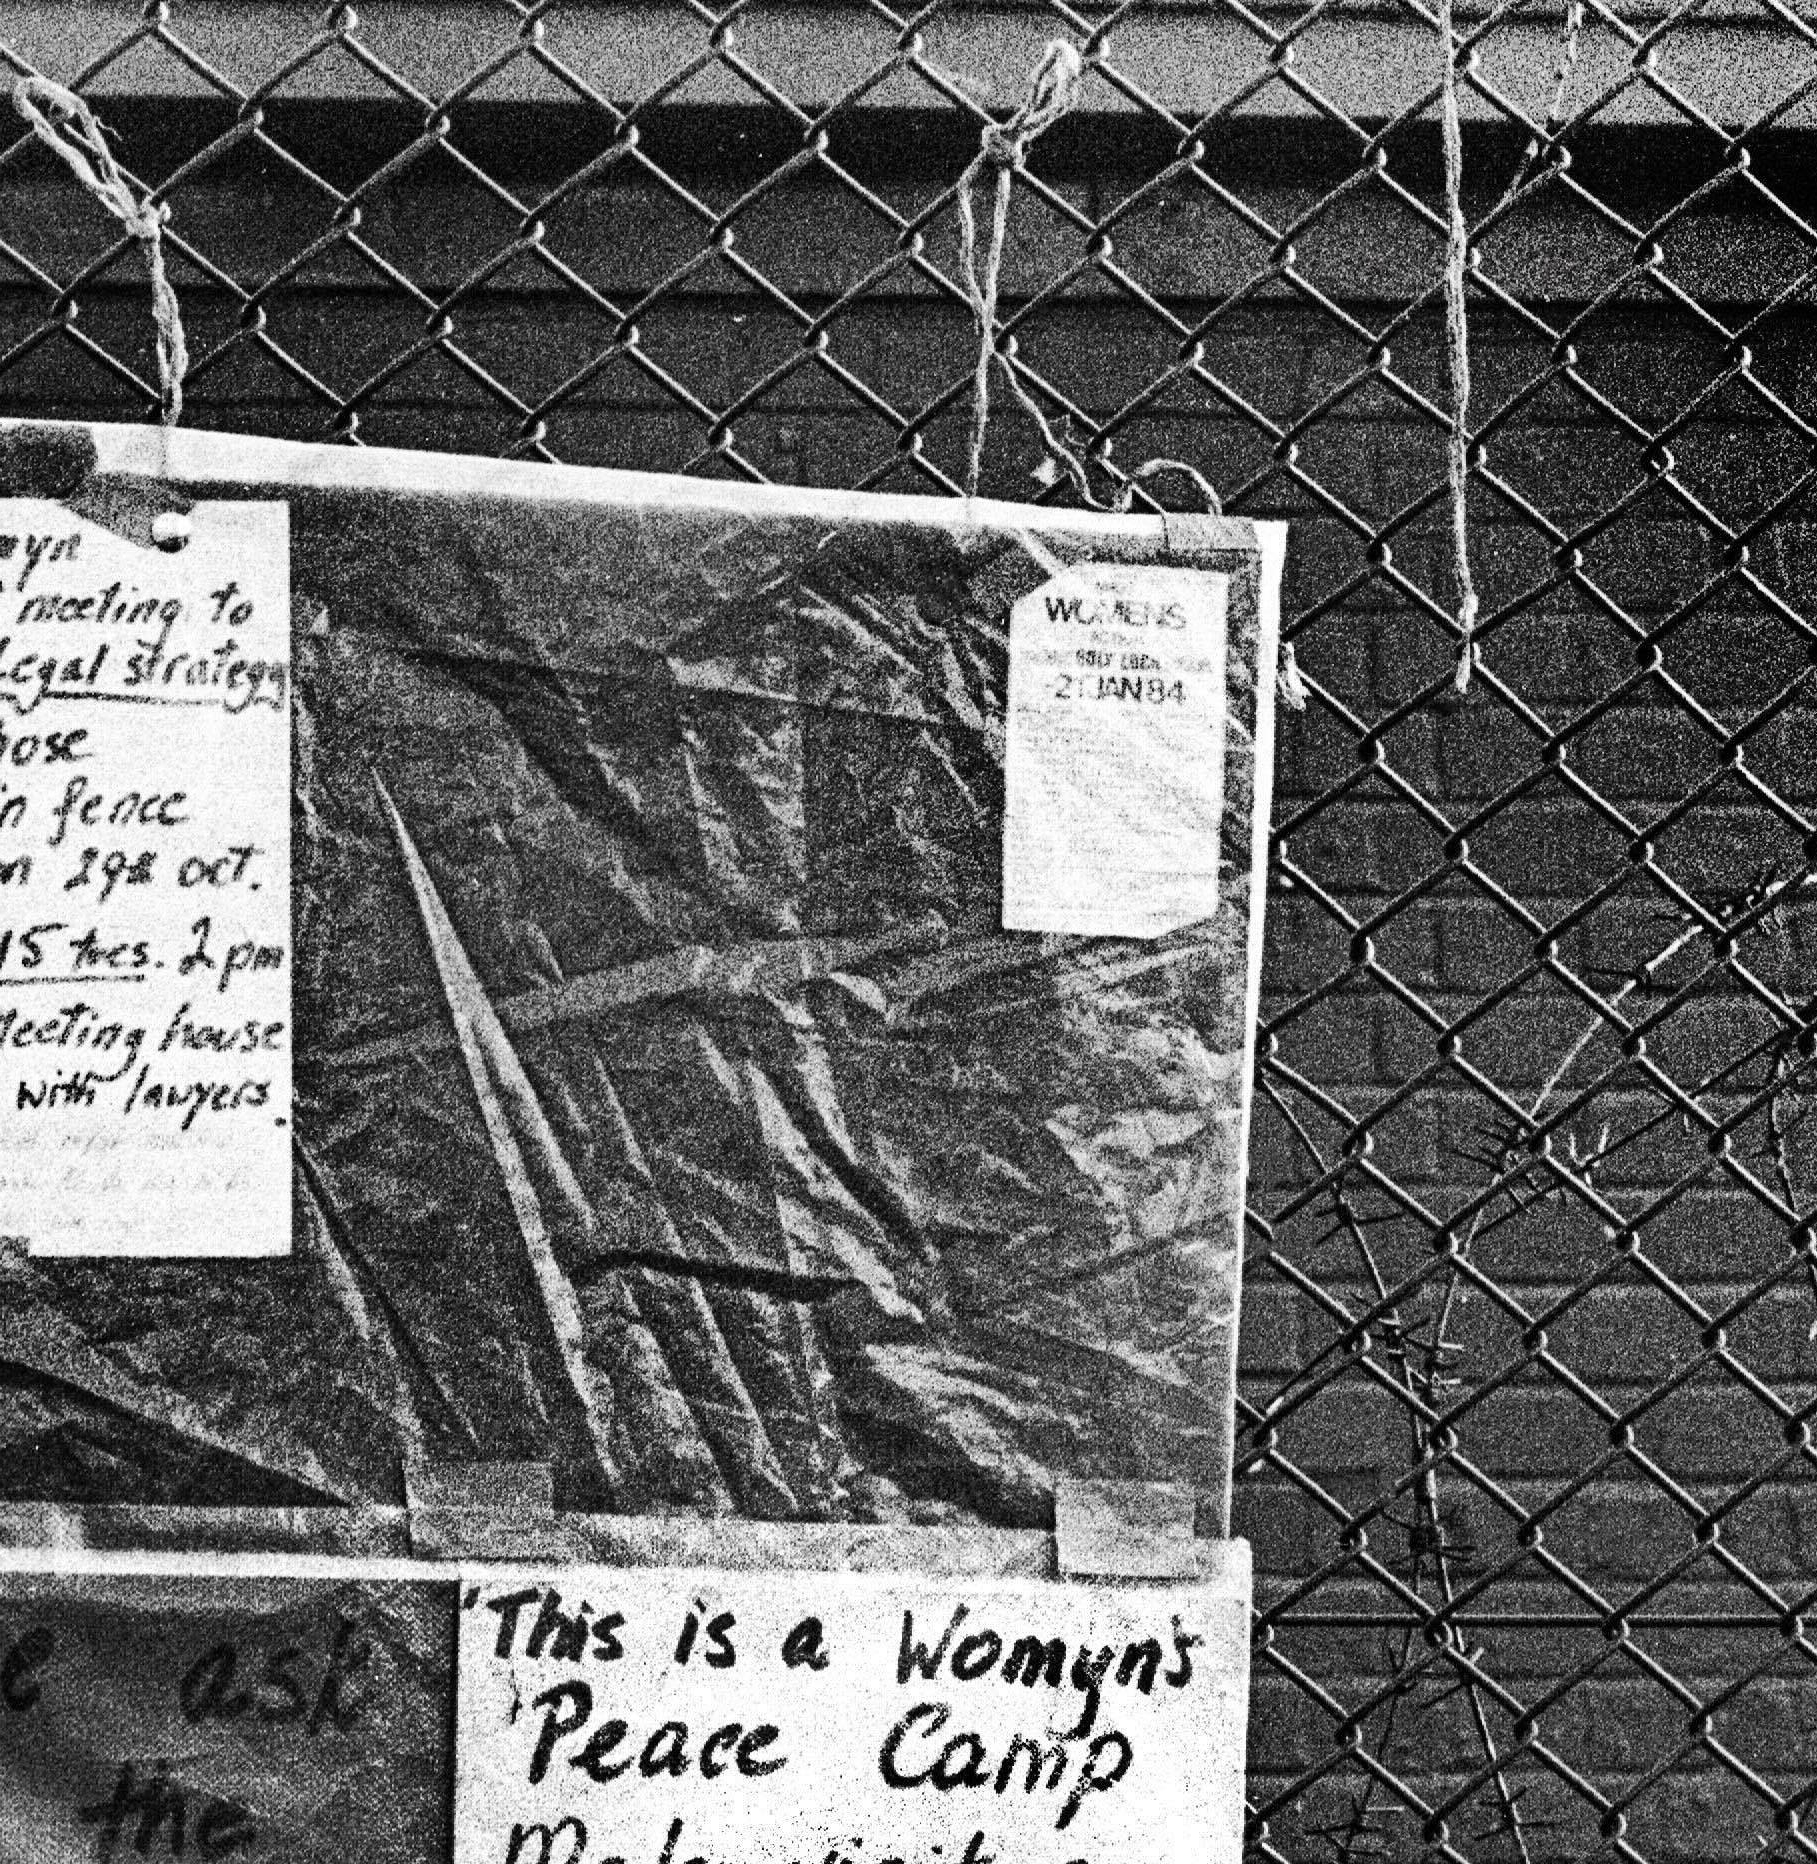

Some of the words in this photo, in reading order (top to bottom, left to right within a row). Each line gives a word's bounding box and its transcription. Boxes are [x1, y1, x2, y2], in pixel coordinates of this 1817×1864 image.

[15, 581, 183, 652] meeting
[211, 581, 255, 626] to
[1045, 597, 1187, 631] WOMENS
[47, 775, 189, 846] fence
[157, 1002, 285, 1053] house
[17, 1068, 96, 1109] with
[673, 1598, 736, 1668] is
[783, 1615, 830, 1671] a
[182, 1618, 373, 1736] ask
[529, 1680, 788, 1784] Peace
[878, 1703, 1135, 1829] Camp
